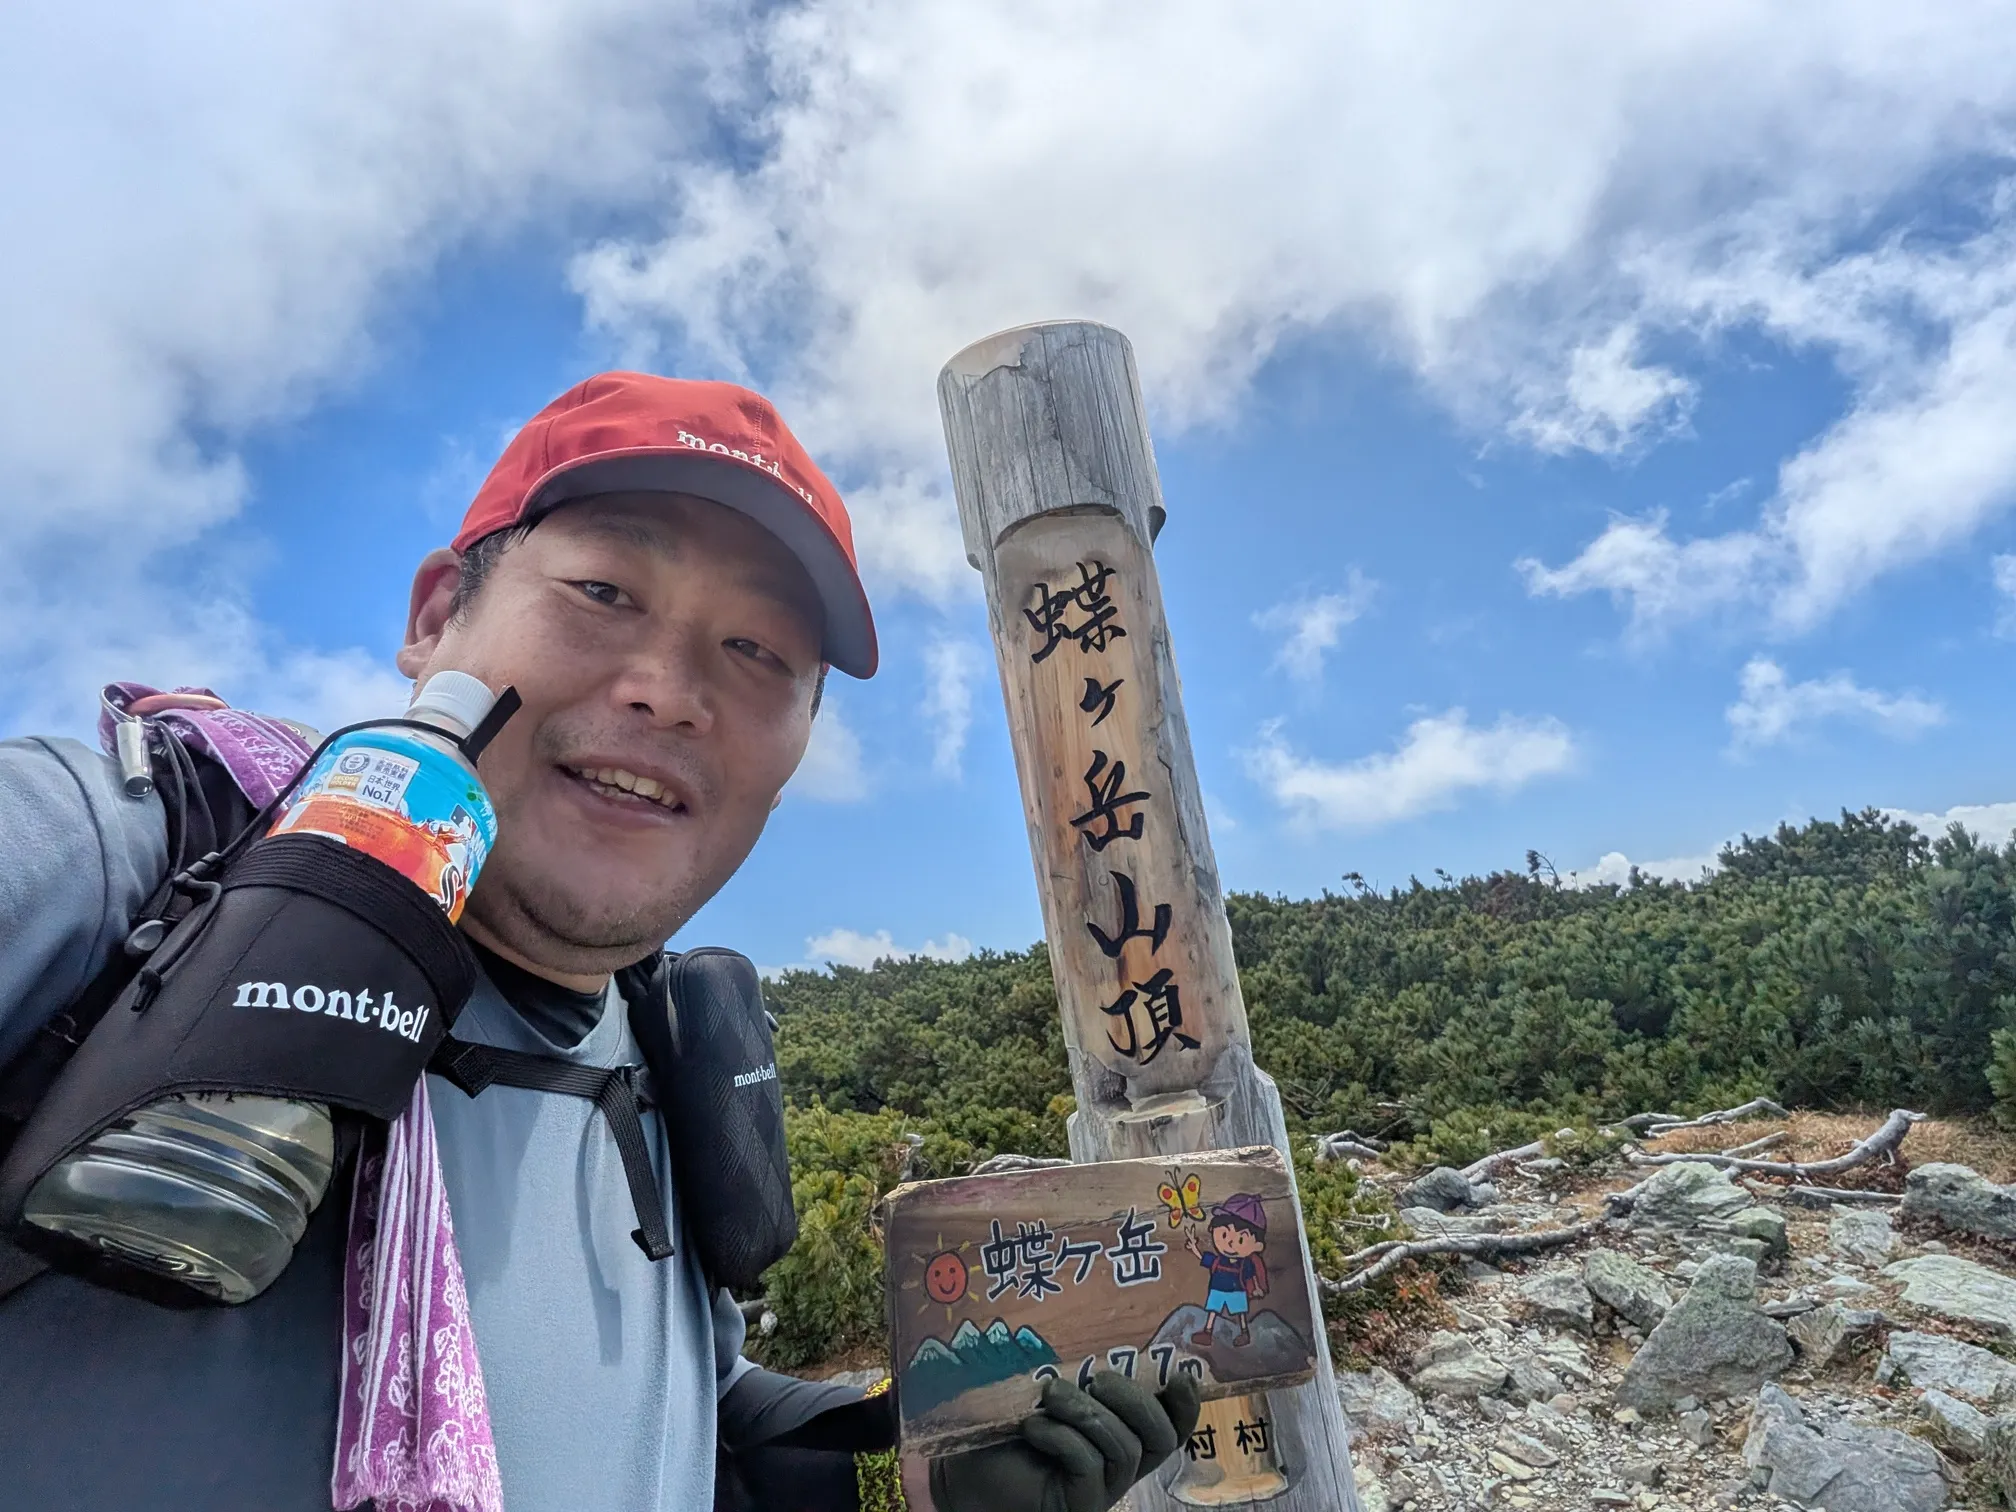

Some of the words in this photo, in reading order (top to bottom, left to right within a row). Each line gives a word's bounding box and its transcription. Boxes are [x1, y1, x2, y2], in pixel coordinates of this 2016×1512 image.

[362, 785, 392, 803] No.1
[1184, 1424, 1217, 1461] 村
[1234, 1417, 1269, 1455] 村
